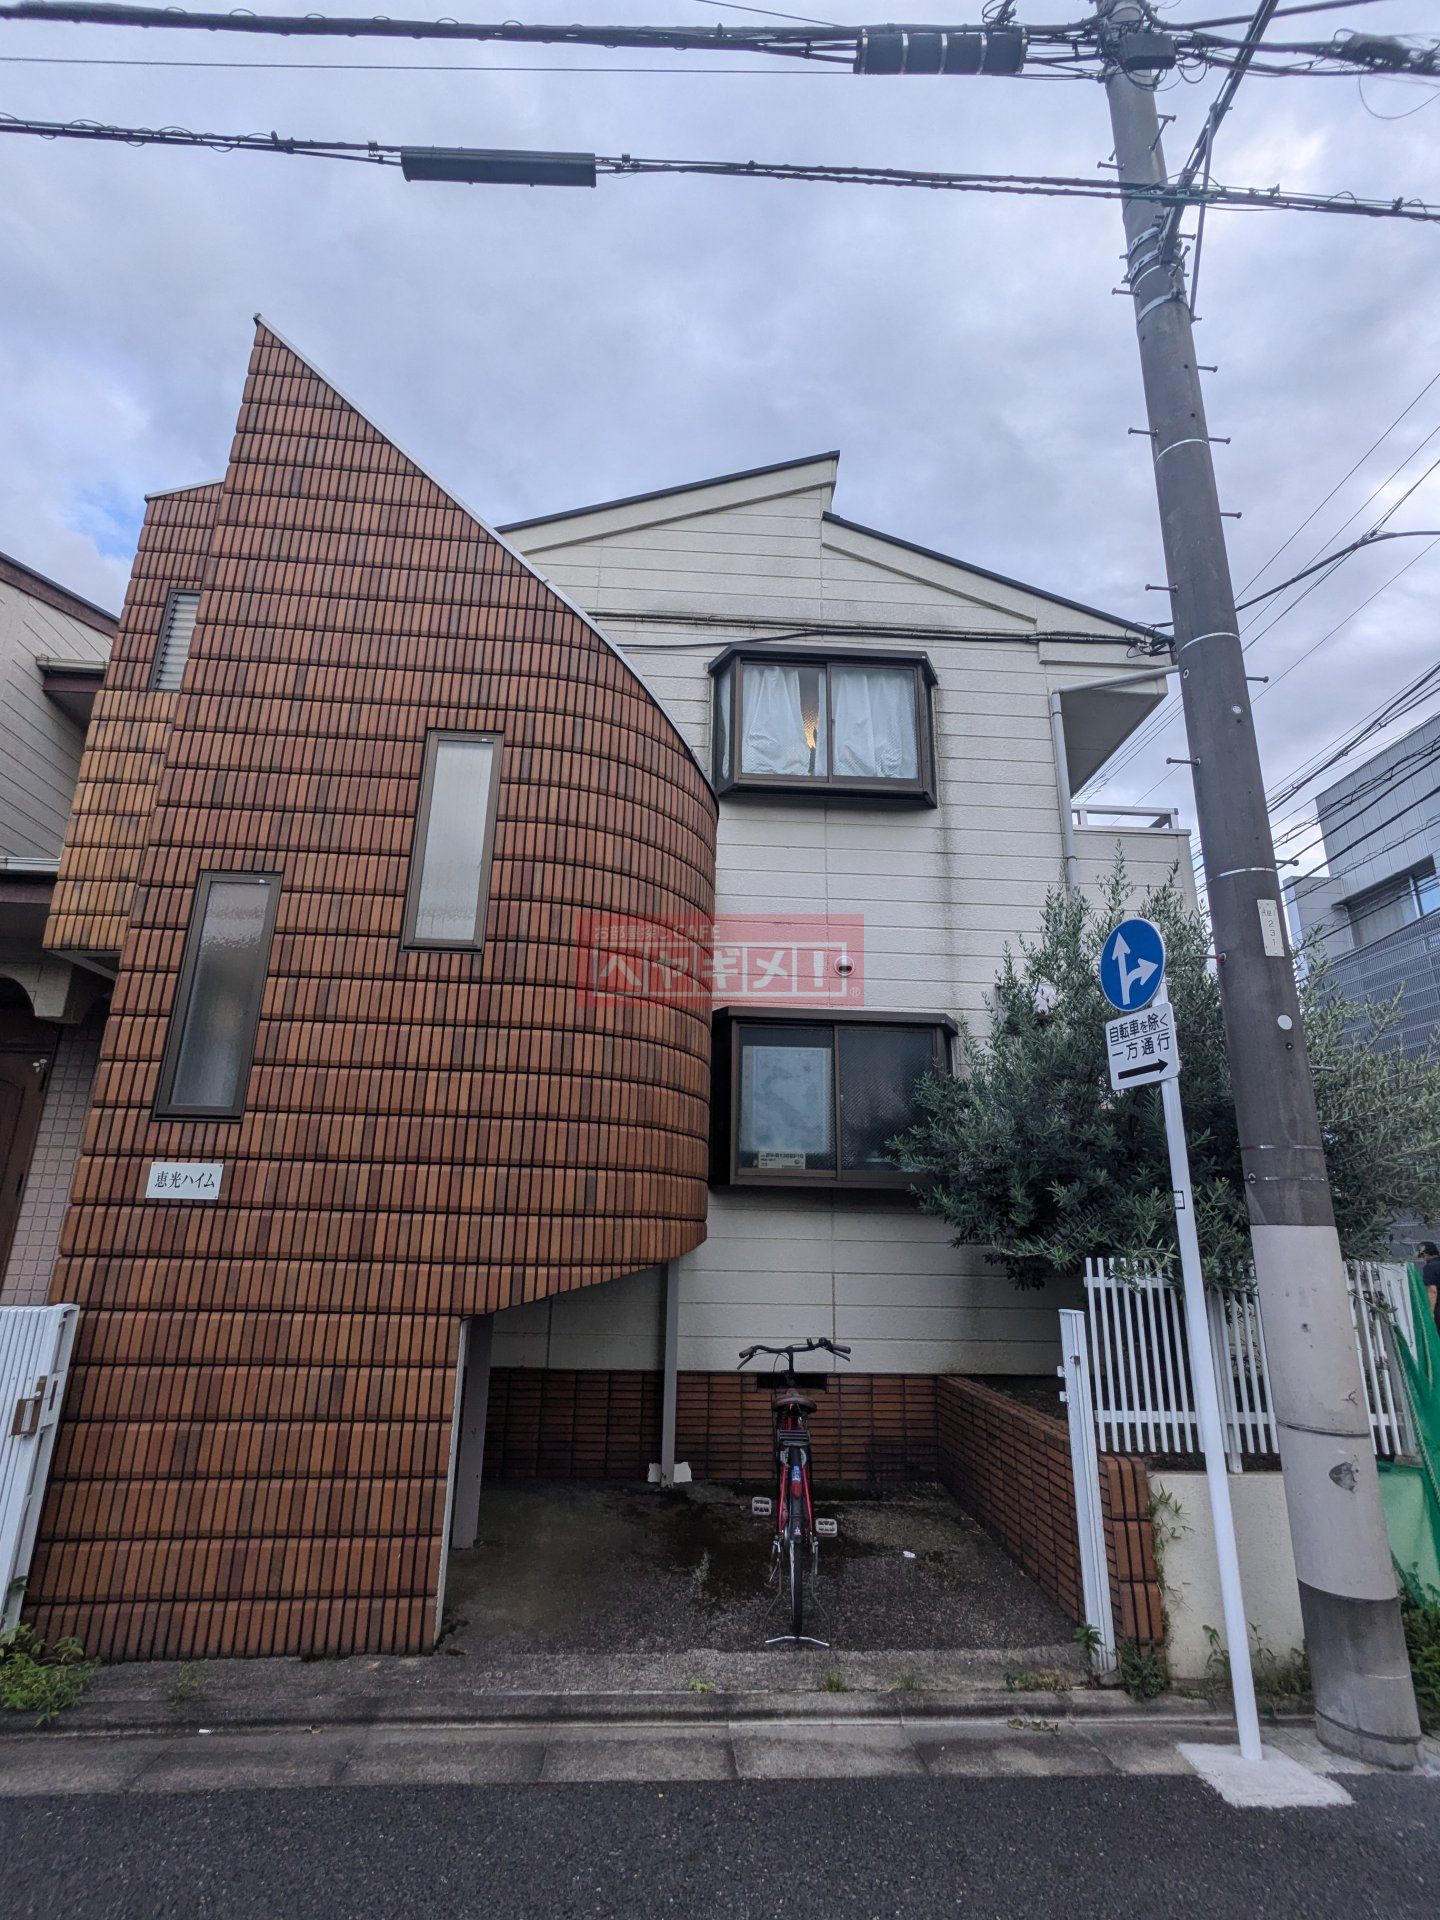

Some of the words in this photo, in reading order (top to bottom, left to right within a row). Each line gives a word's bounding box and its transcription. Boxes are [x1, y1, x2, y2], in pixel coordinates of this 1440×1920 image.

[1109, 1013, 1169, 1043] 自転車を除く
[1112, 1033, 1170, 1060] 一方通行
[155, 1171, 215, 1188] 恵光ハイム
